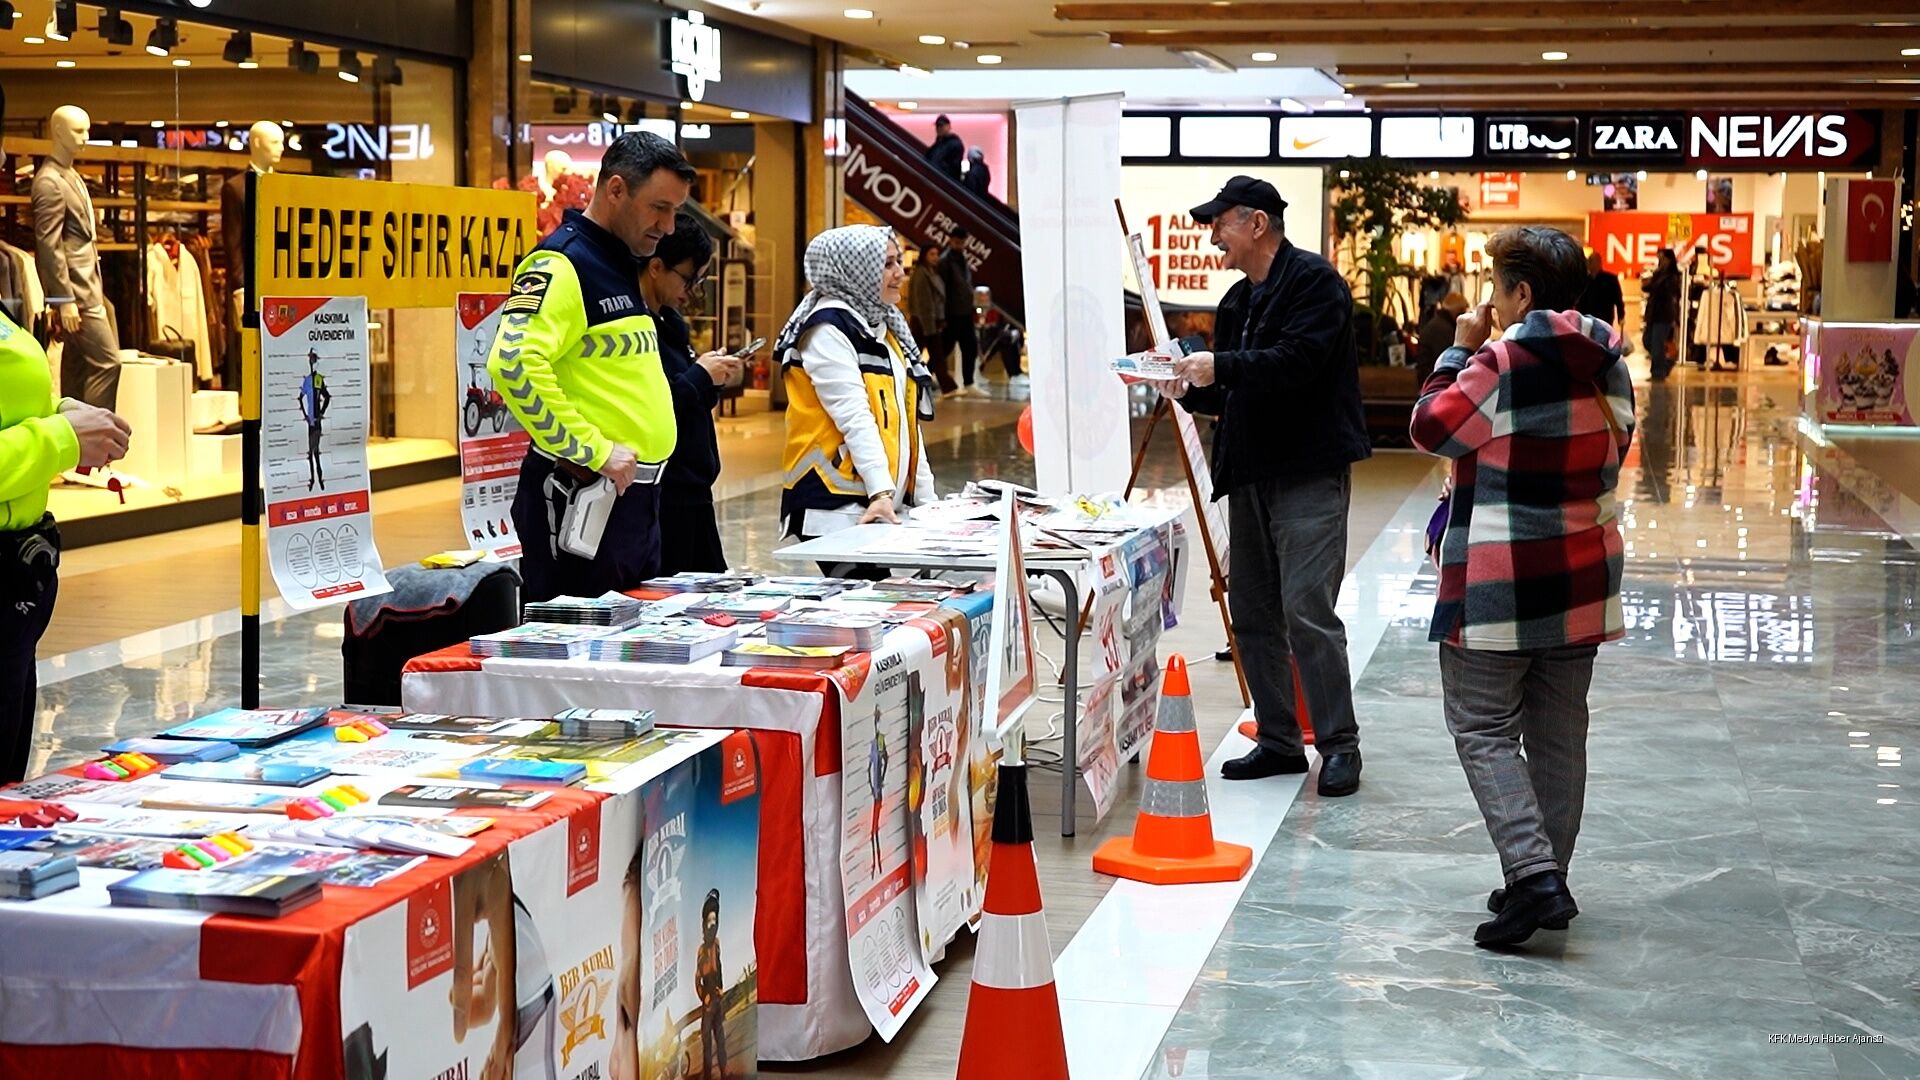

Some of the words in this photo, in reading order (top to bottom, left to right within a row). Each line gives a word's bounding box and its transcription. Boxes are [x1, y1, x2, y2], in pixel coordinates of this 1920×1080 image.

[1489, 124, 1529, 151] LTB
[1594, 125, 1678, 151] ZARA
[273, 206, 373, 279] HEDEF
[382, 211, 452, 279] SIFIR
[460, 215, 527, 279] KAZA
[1147, 214, 1161, 250] 1
[1168, 234, 1202, 250] BUY
[1167, 274, 1209, 290] FREE
[559, 966, 580, 1006] BİR
